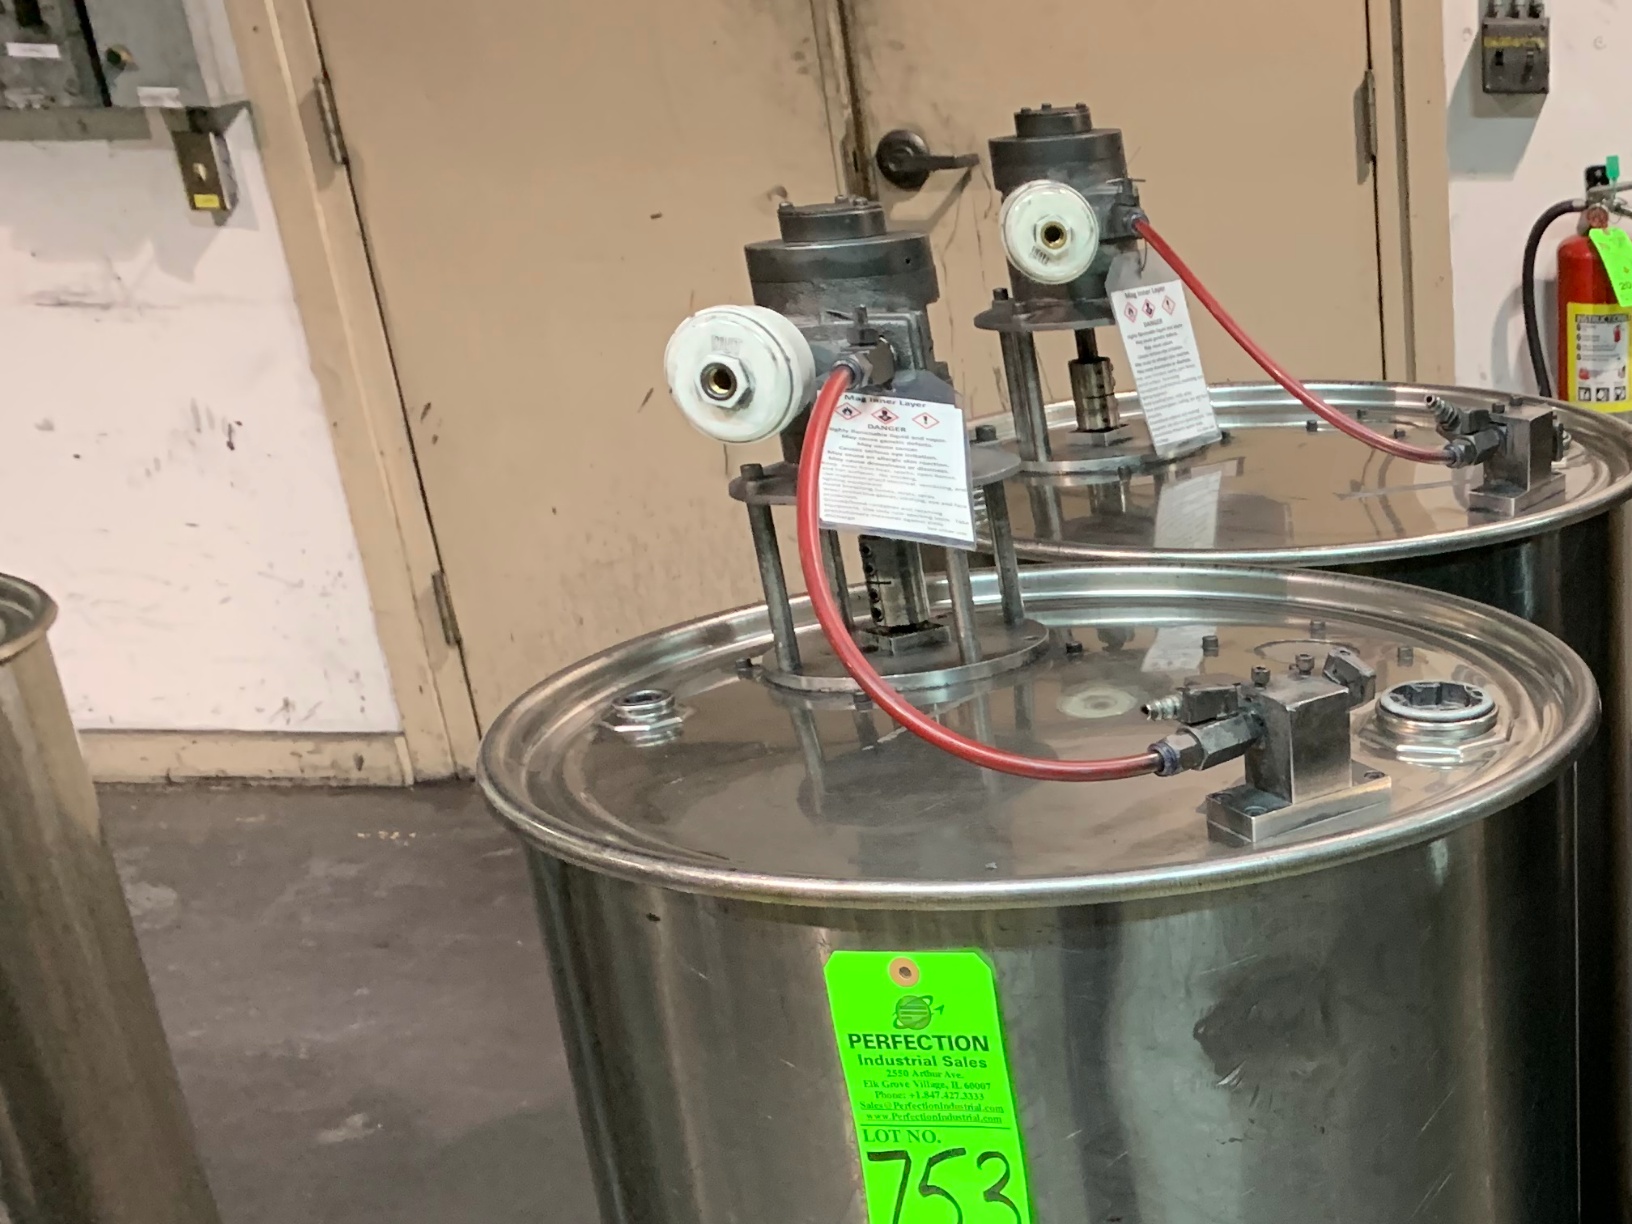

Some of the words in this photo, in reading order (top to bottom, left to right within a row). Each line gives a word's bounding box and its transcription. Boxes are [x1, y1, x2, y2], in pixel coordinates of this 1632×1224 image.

[868, 424, 906, 432] DANGER
[848, 1034, 989, 1051] PERFECTION
[858, 1054, 937, 1067] Industrial
[942, 1056, 987, 1068] Sales
[912, 1070, 942, 1078] Arthur
[863, 1080, 879, 1088] Elk
[875, 1091, 906, 1099] Phone:
[863, 1129, 900, 1142] LOT
[906, 1130, 942, 1143] NO.
